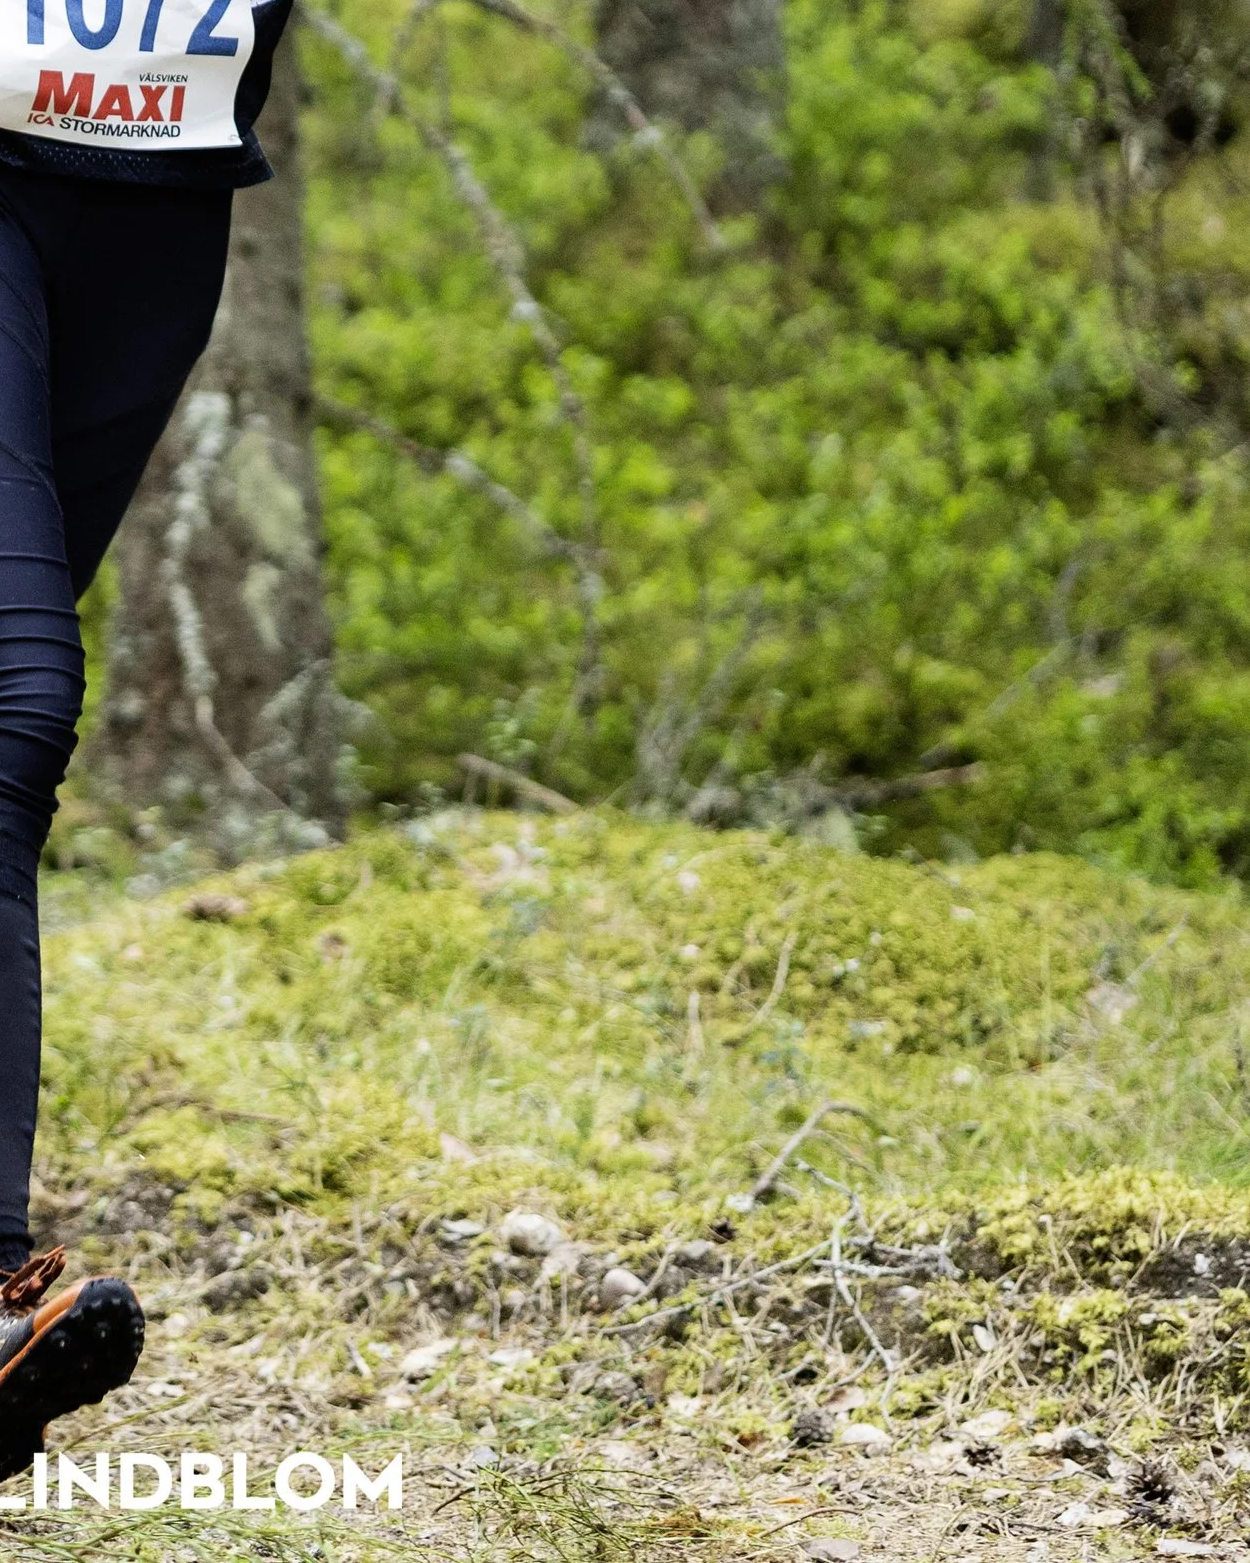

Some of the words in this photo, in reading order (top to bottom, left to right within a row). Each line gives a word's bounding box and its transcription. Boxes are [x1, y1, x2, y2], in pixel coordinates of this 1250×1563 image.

[139, 72, 189, 83] VÄLSVIKEN
[31, 69, 186, 122] MAXI
[27, 112, 55, 127] ICA
[59, 116, 181, 138] STORMARKNAD
